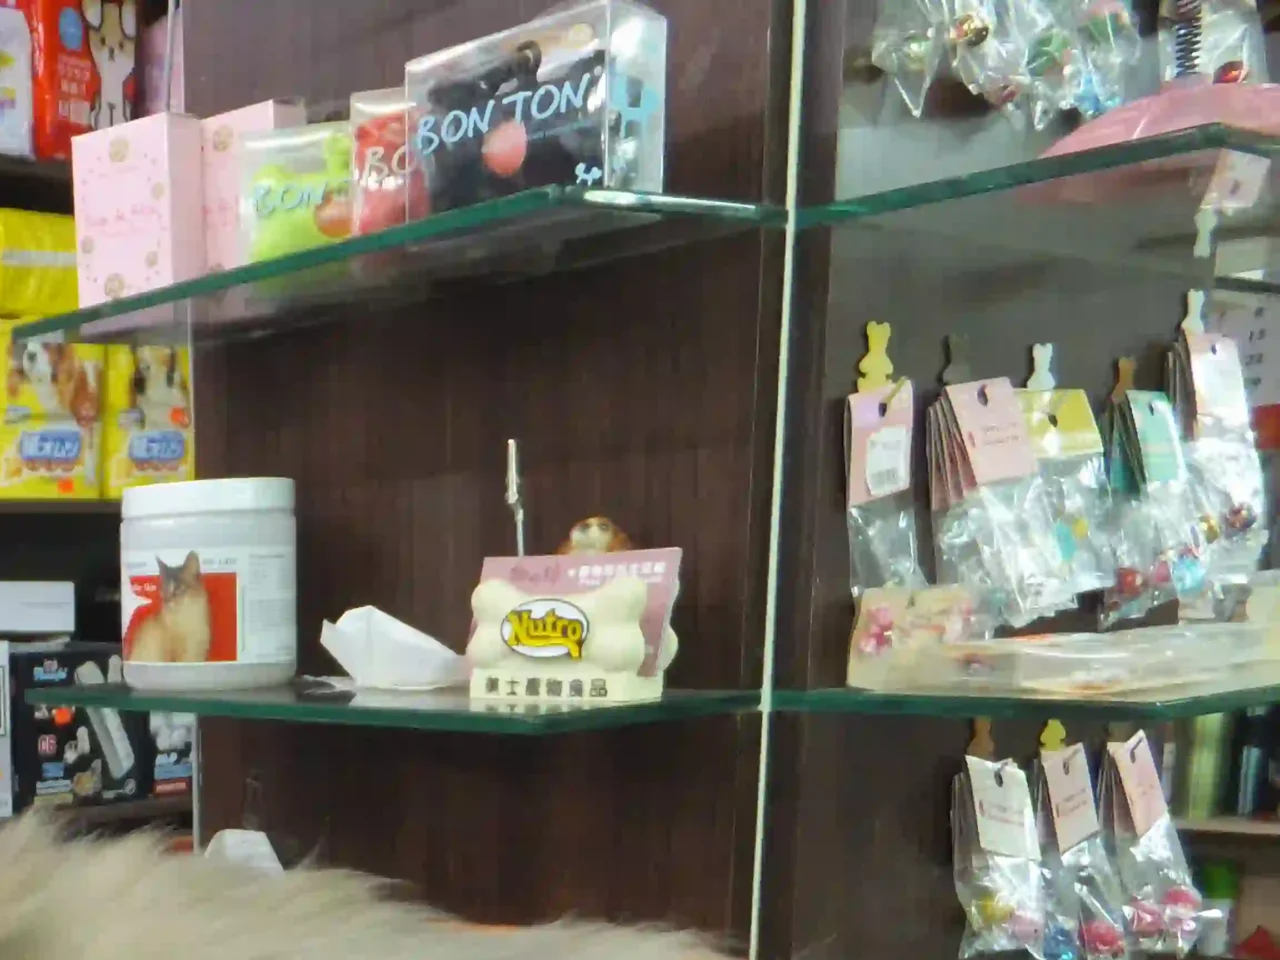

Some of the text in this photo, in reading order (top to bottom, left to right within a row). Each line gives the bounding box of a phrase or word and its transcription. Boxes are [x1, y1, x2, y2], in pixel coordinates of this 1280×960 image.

[416, 72, 591, 156] BON TON
[506, 607, 586, 661] Nutro
